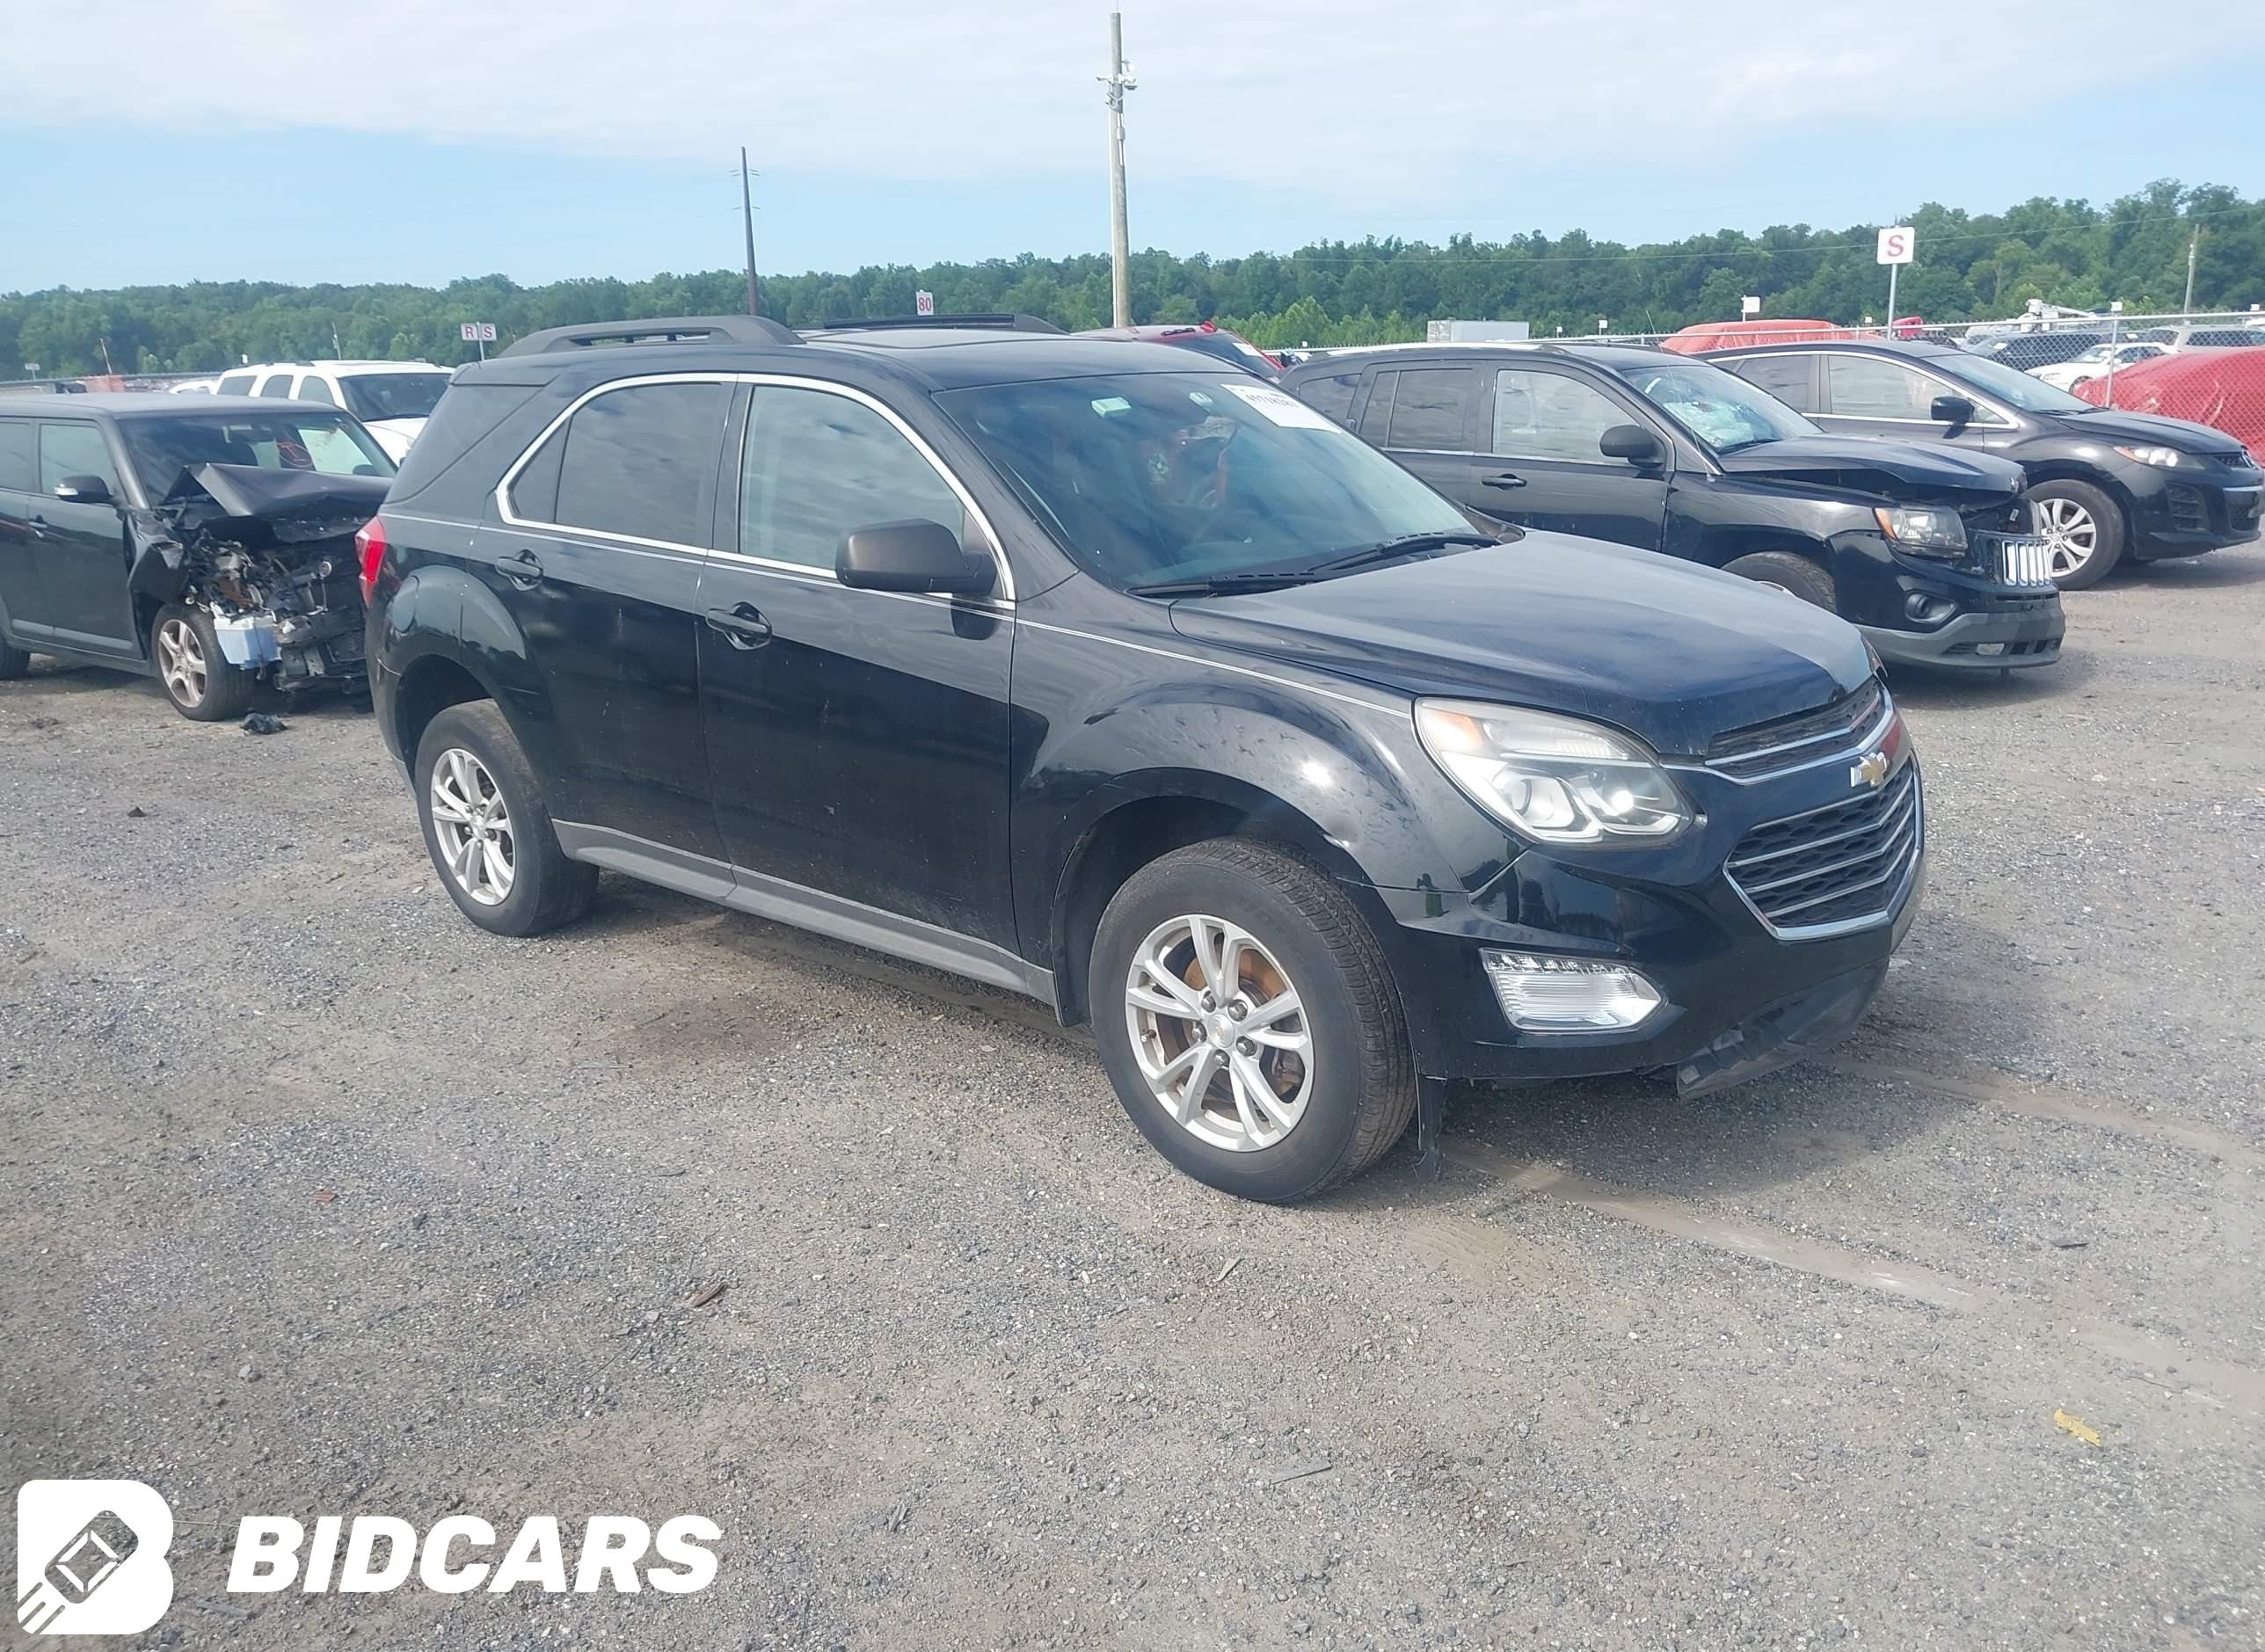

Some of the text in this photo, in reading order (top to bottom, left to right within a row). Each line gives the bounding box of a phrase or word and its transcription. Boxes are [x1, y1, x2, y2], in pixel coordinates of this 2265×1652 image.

[1886, 234, 1904, 257] S
[918, 297, 932, 311] 80
[464, 326, 474, 338] R
[484, 326, 492, 338] S
